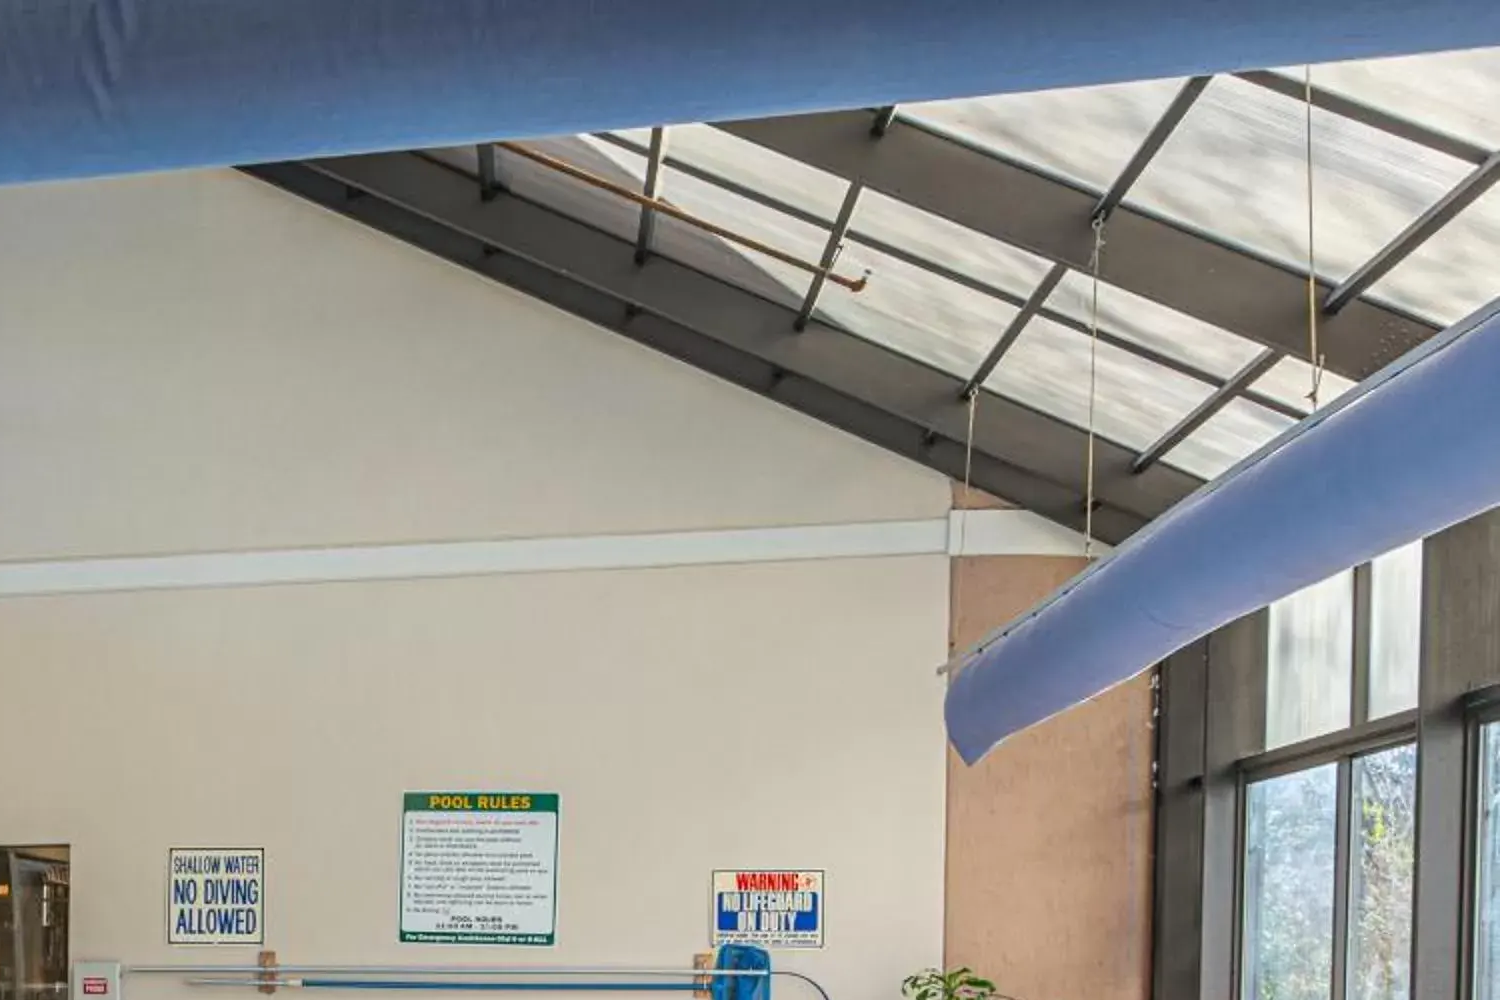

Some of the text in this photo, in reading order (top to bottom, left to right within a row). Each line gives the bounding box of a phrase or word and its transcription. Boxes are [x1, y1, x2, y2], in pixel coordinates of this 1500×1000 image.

[429, 795, 531, 809] POOL RULES
[173, 855, 259, 874] SHALLOW WATER
[173, 878, 259, 905] NO DIVING
[735, 873, 799, 891] WARNING
[722, 892, 813, 912] NO LIFEGUARD
[175, 908, 257, 935] ALLOWED
[737, 911, 797, 931] ON DUTY
